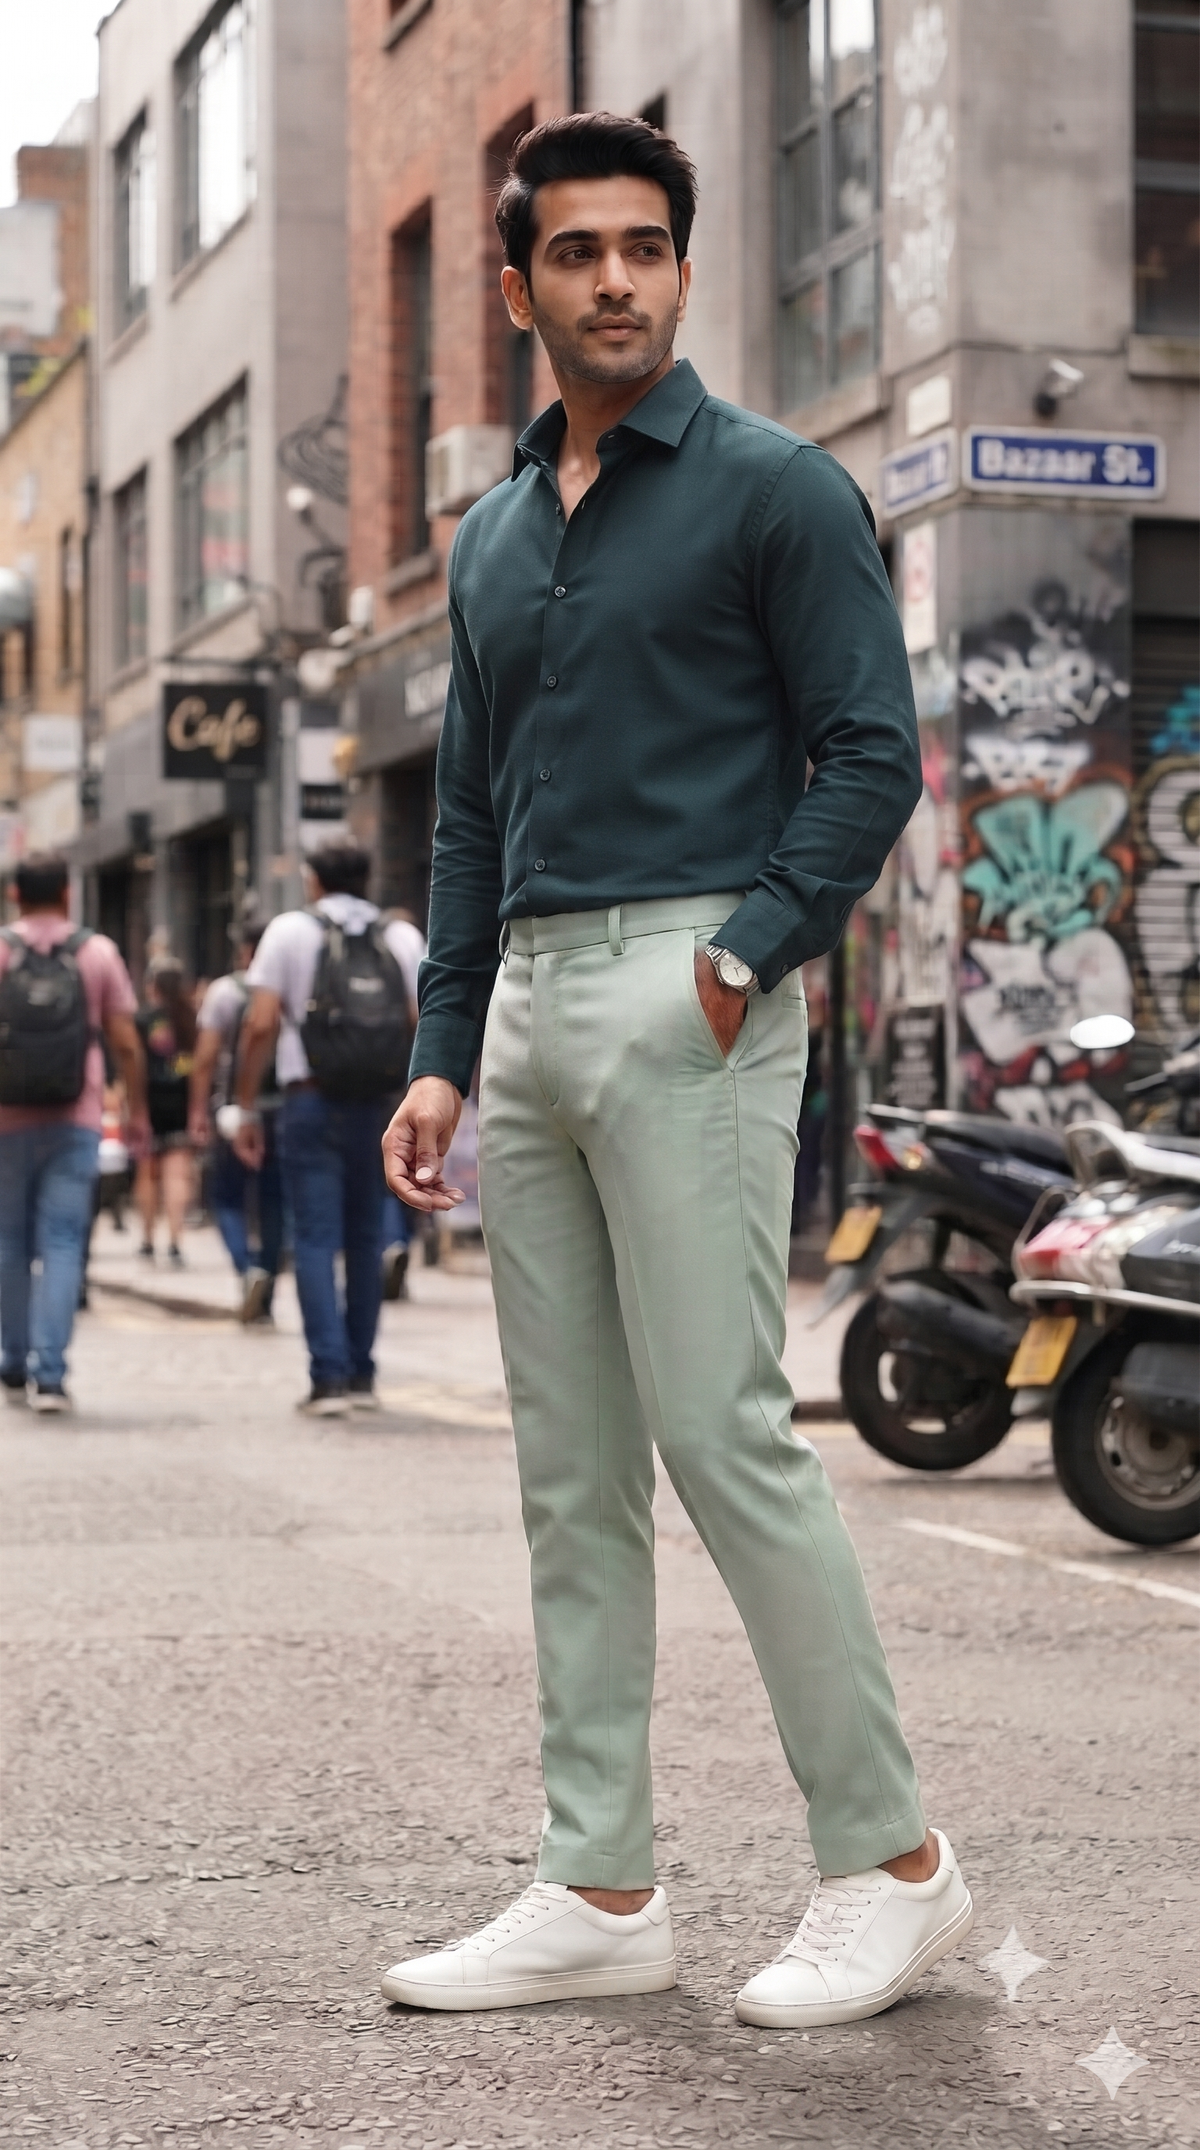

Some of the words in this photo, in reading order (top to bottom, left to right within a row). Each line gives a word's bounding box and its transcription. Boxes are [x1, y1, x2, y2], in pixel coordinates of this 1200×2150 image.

[977, 438, 1096, 482] Bazaar
[1102, 444, 1151, 484] St.
[167, 695, 262, 762] Cafe
